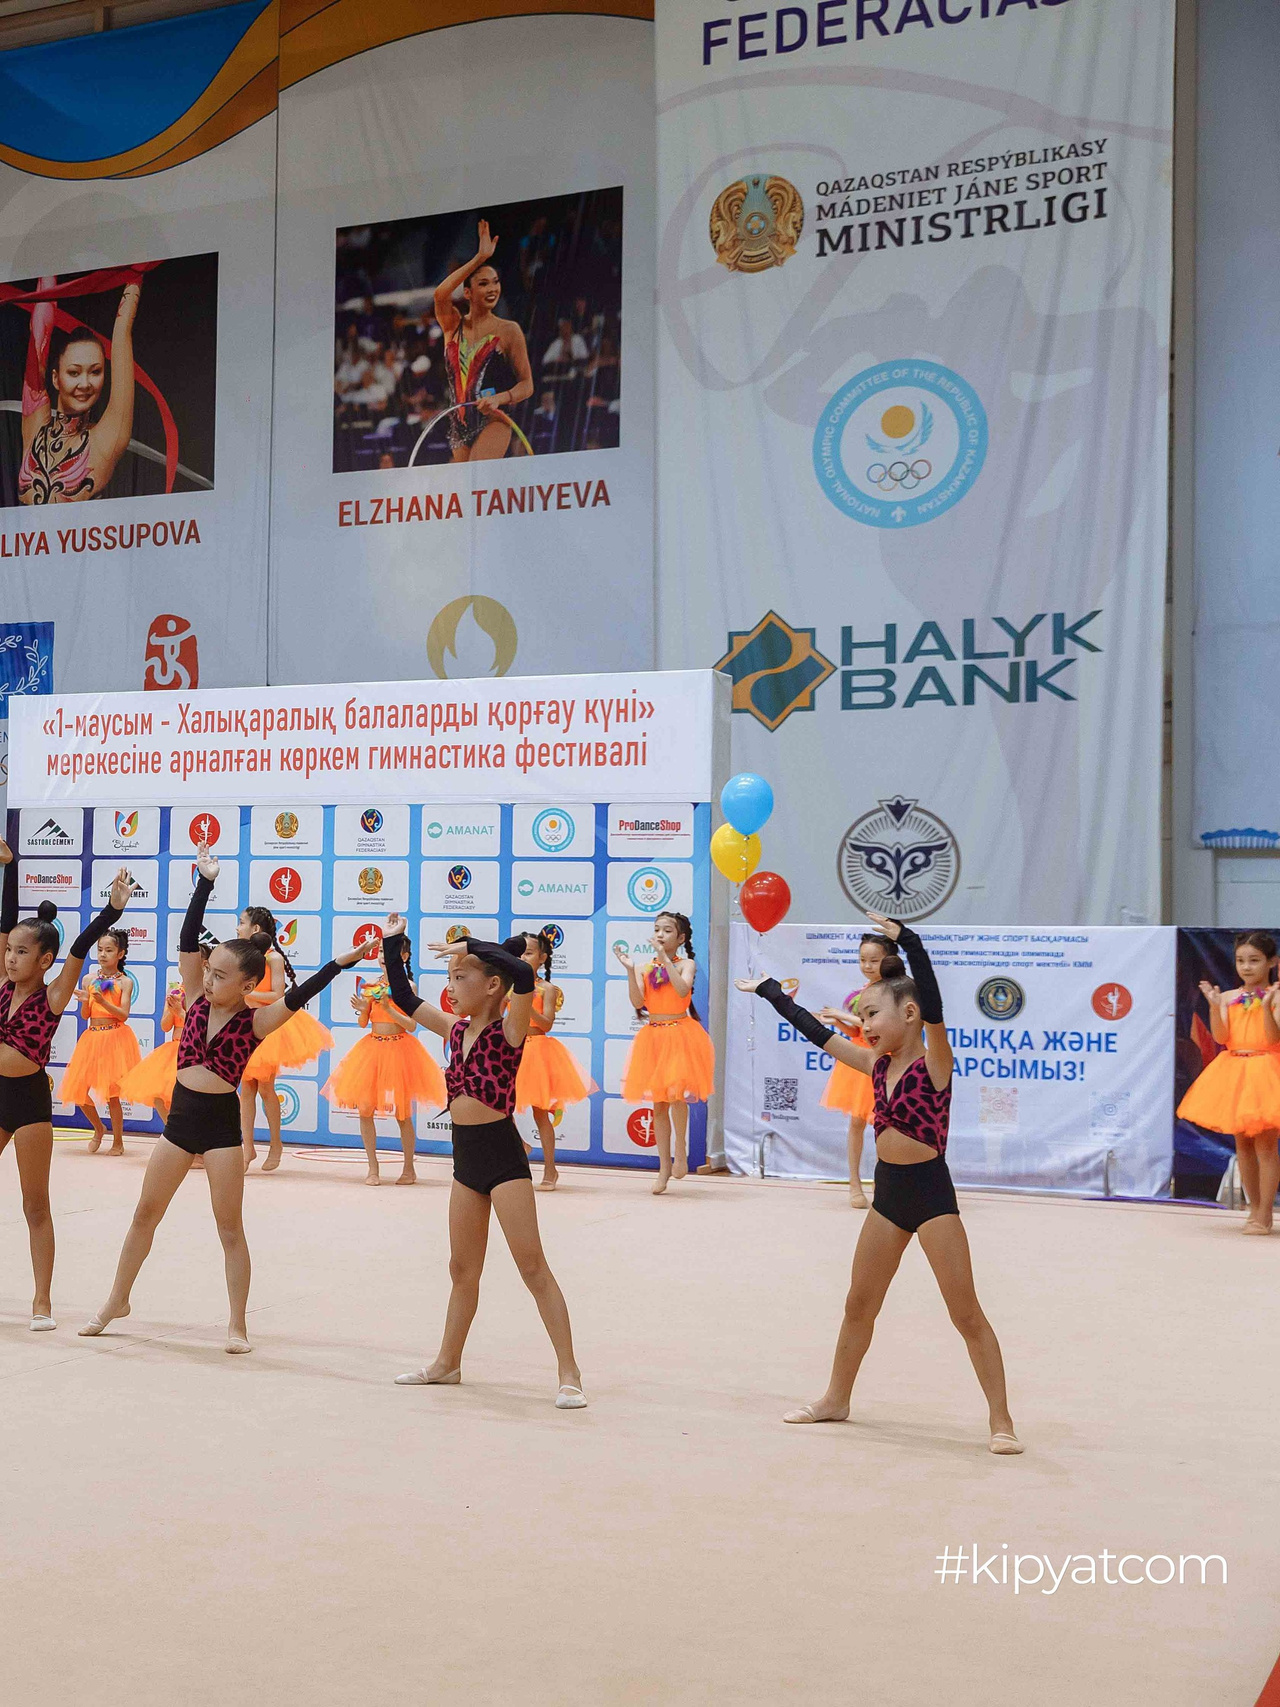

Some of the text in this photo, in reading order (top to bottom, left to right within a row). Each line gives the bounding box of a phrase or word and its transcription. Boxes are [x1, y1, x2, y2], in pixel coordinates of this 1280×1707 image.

[702, 0, 1070, 66] FEDERAC
[815, 138, 1109, 196] QAZAQSTAN RESPÝBLIKASY
[815, 162, 1108, 222] MÁDENIET JÁNE SPORT
[815, 187, 1108, 258] MINISTRLIGI
[892, 368, 910, 379] OF
[913, 368, 939, 383] THE
[337, 480, 612, 529] ELZHANA TANIYEVA
[56, 519, 202, 554] YUSSUPOVA
[841, 609, 1104, 667] HALYK
[841, 657, 1078, 711] BANK
[177, 702, 337, 741] Халықаралық
[344, 697, 479, 737] балаларды
[488, 698, 576, 735] қорғау
[584, 688, 656, 733] күні»
[46, 731, 648, 784] мерекесіне арналған көркем гимнастика фестивалі
[445, 825, 495, 836] AMANAT
[618, 819, 682, 833] ProDanceShop
[25, 873, 73, 885] ProDanceShop
[130, 891, 149, 899] EMENT
[537, 883, 589, 894] AMANAT
[1042, 1031, 1118, 1053] ЖӘНЕ
[952, 1057, 1085, 1082] АРСЫМЫЗ!
[426, 1121, 453, 1131] SASTOB
